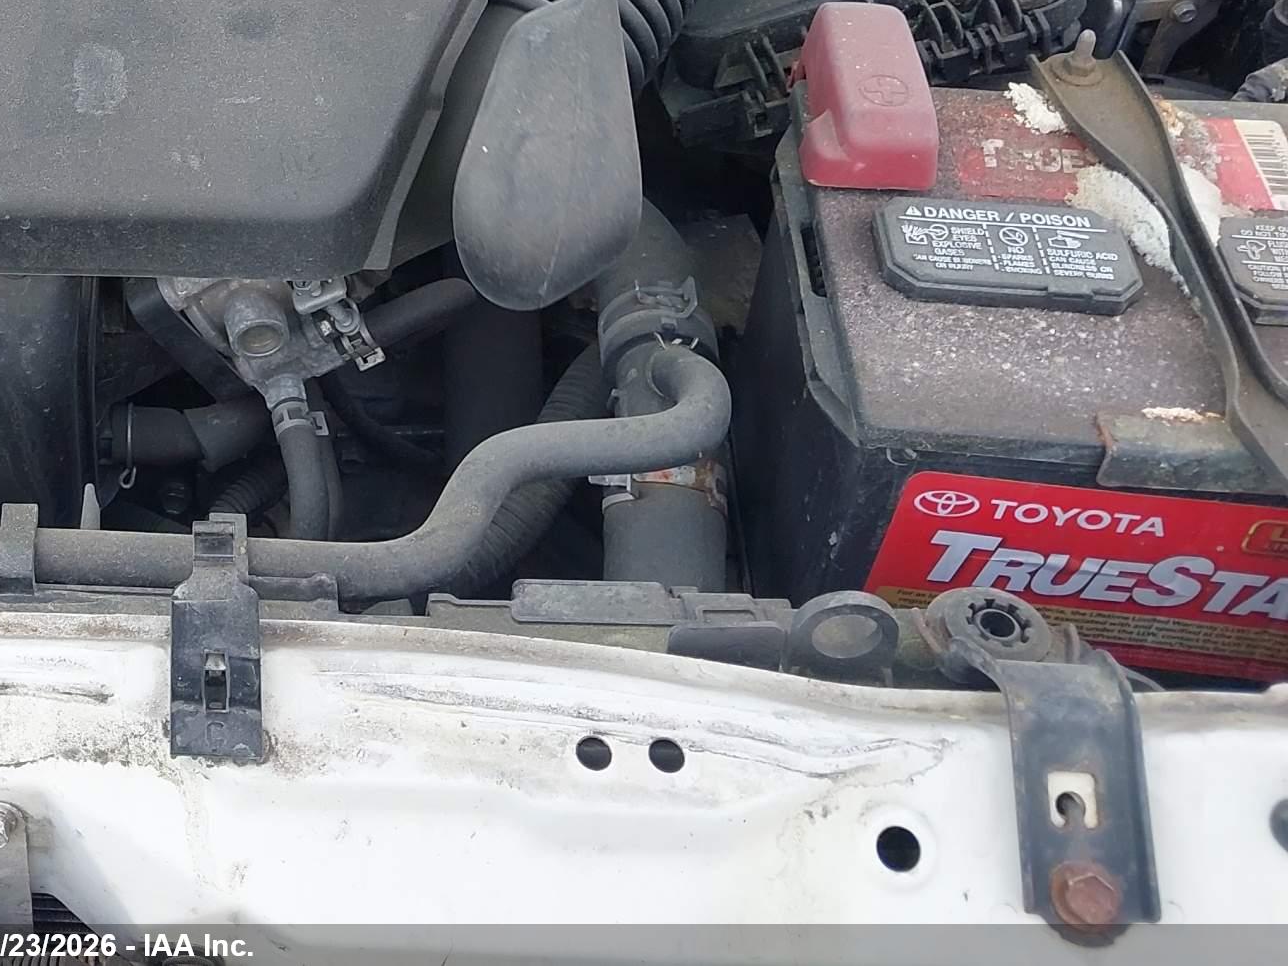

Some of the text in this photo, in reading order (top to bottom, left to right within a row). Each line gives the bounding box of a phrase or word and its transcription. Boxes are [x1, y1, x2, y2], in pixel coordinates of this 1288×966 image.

[924, 206, 1001, 222] DANGER
[1019, 213, 1092, 228] POISON
[951, 227, 985, 236] SHIELD
[932, 241, 983, 250] EXPLOSIVE
[1007, 246, 1025, 254] NO
[934, 248, 966, 256] GASES
[1046, 248, 1119, 261] SULFURIC ACID
[990, 499, 1165, 537] TOYOTA
